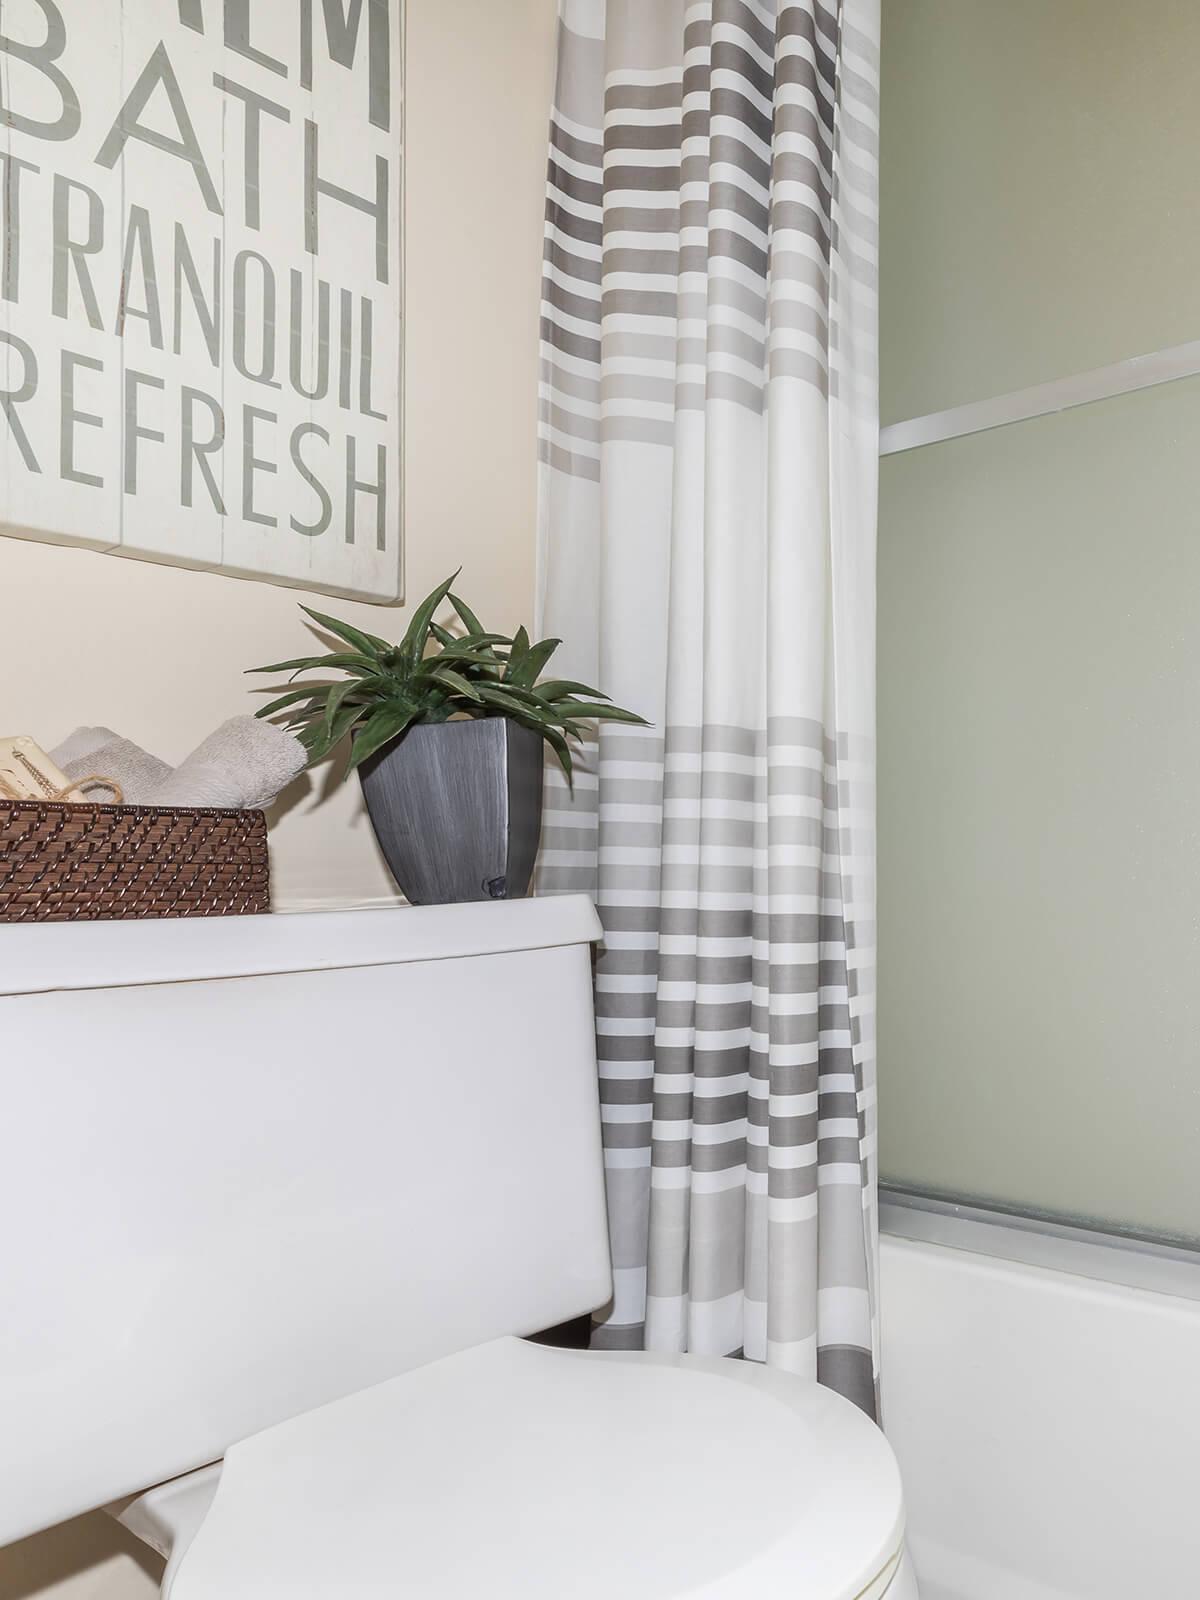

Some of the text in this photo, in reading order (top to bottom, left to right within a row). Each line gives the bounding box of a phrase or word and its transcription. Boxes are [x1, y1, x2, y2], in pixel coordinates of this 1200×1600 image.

[0, 0, 389, 285] BATH
[0, 152, 388, 421] TRANQUIL
[0, 331, 387, 552] REFRESH
